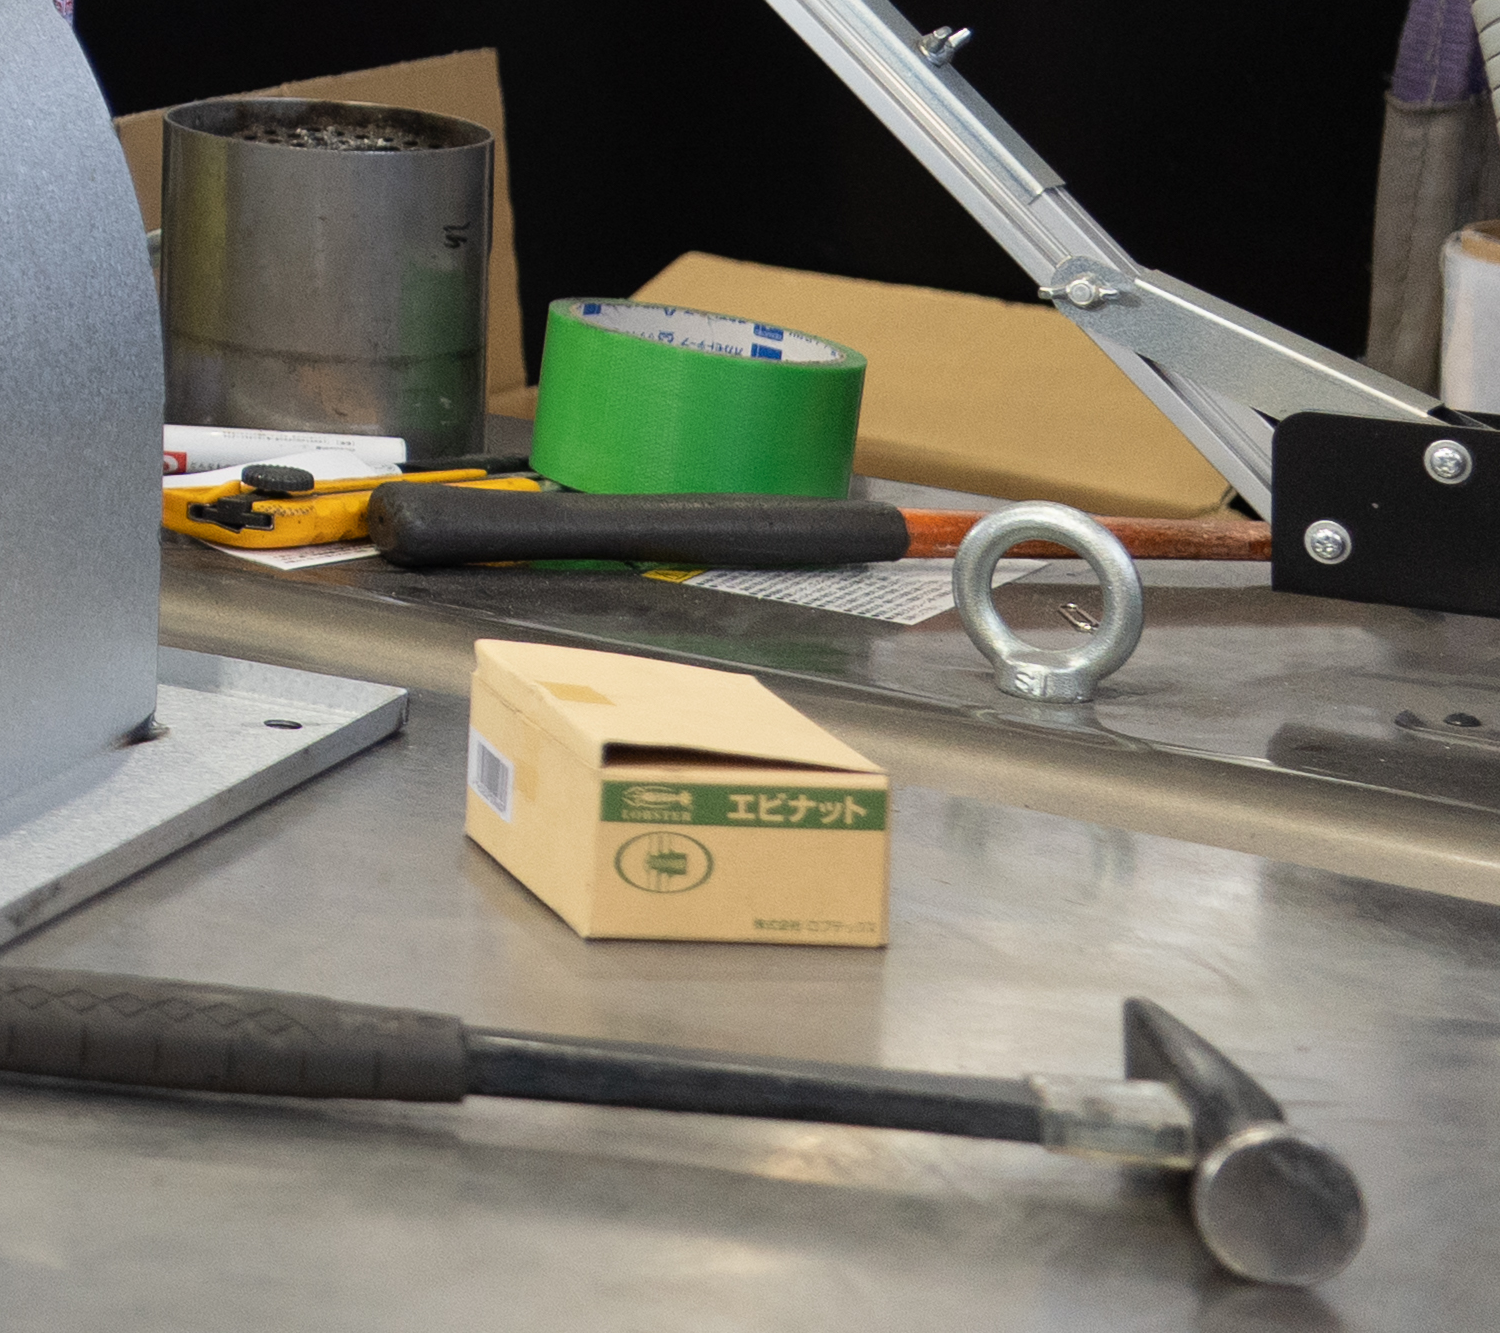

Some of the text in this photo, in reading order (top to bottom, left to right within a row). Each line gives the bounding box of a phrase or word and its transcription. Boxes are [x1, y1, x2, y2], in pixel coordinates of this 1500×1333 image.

[725, 792, 868, 825] エビナット
